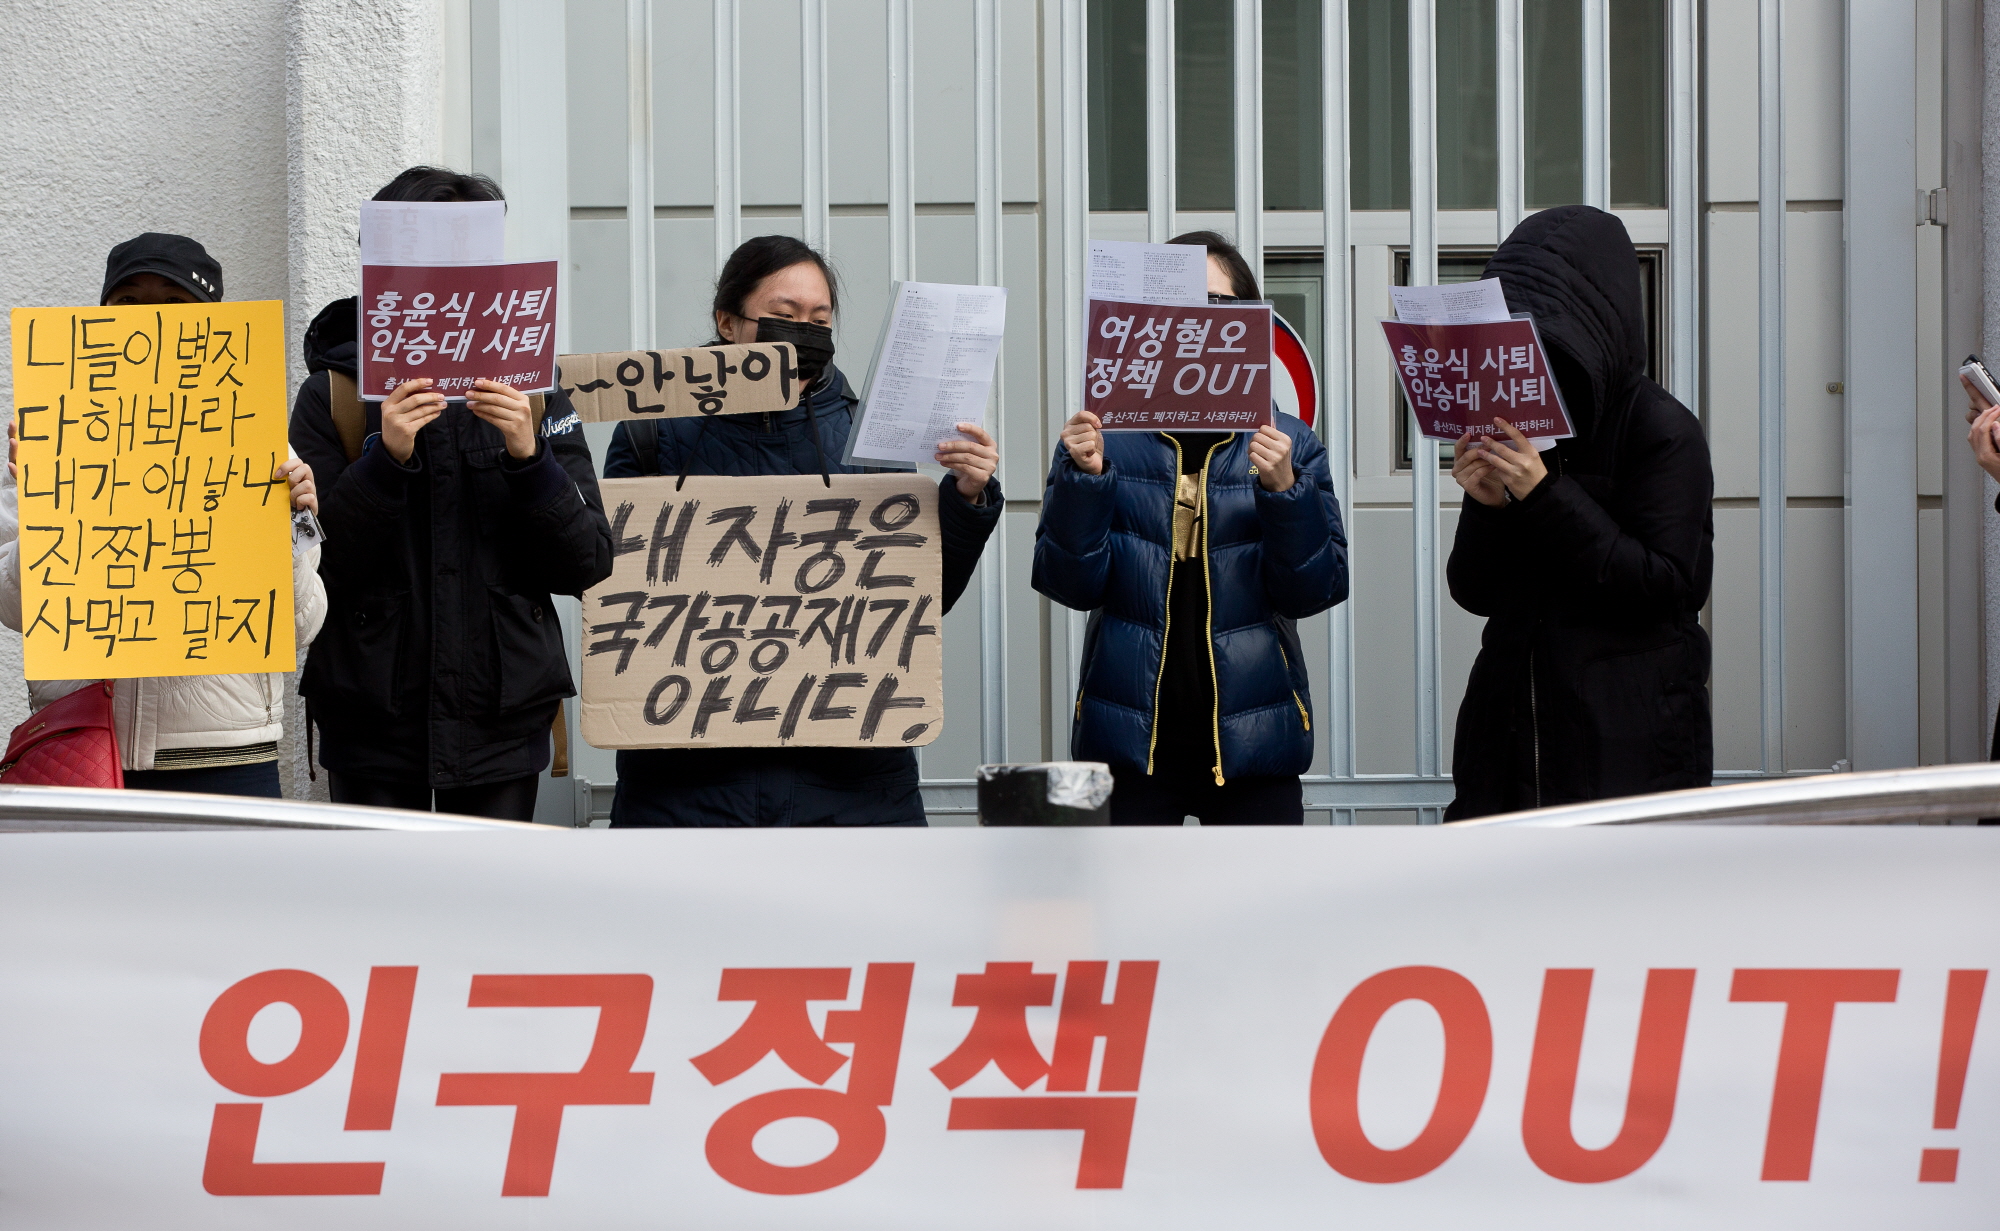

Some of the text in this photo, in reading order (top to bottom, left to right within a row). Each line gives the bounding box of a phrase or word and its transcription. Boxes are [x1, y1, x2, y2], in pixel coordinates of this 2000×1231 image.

[366, 287, 552, 328] 홍윤식 사퇴
[27, 311, 251, 392] 니들이 별짓
[370, 323, 552, 366] 안승대 사퇴
[1100, 315, 1247, 358] 여성혐오
[1087, 357, 1268, 399] 정책 OUT
[1400, 343, 1534, 380] 홍윤식 사퇴
[1411, 376, 1546, 412] 안승대 사퇴
[1101, 411, 1257, 424] 출산지도 폐지하고 사죄하라!
[1433, 420, 1464, 435] 출산지도
[24, 457, 130, 516] 내가
[142, 456, 191, 512] 애
[609, 493, 929, 595] 내 자궁은
[25, 588, 277, 660] 사먹고 말지
[643, 672, 933, 746] 아니다.
[199, 960, 1990, 1198] 인구정책 OUT!
